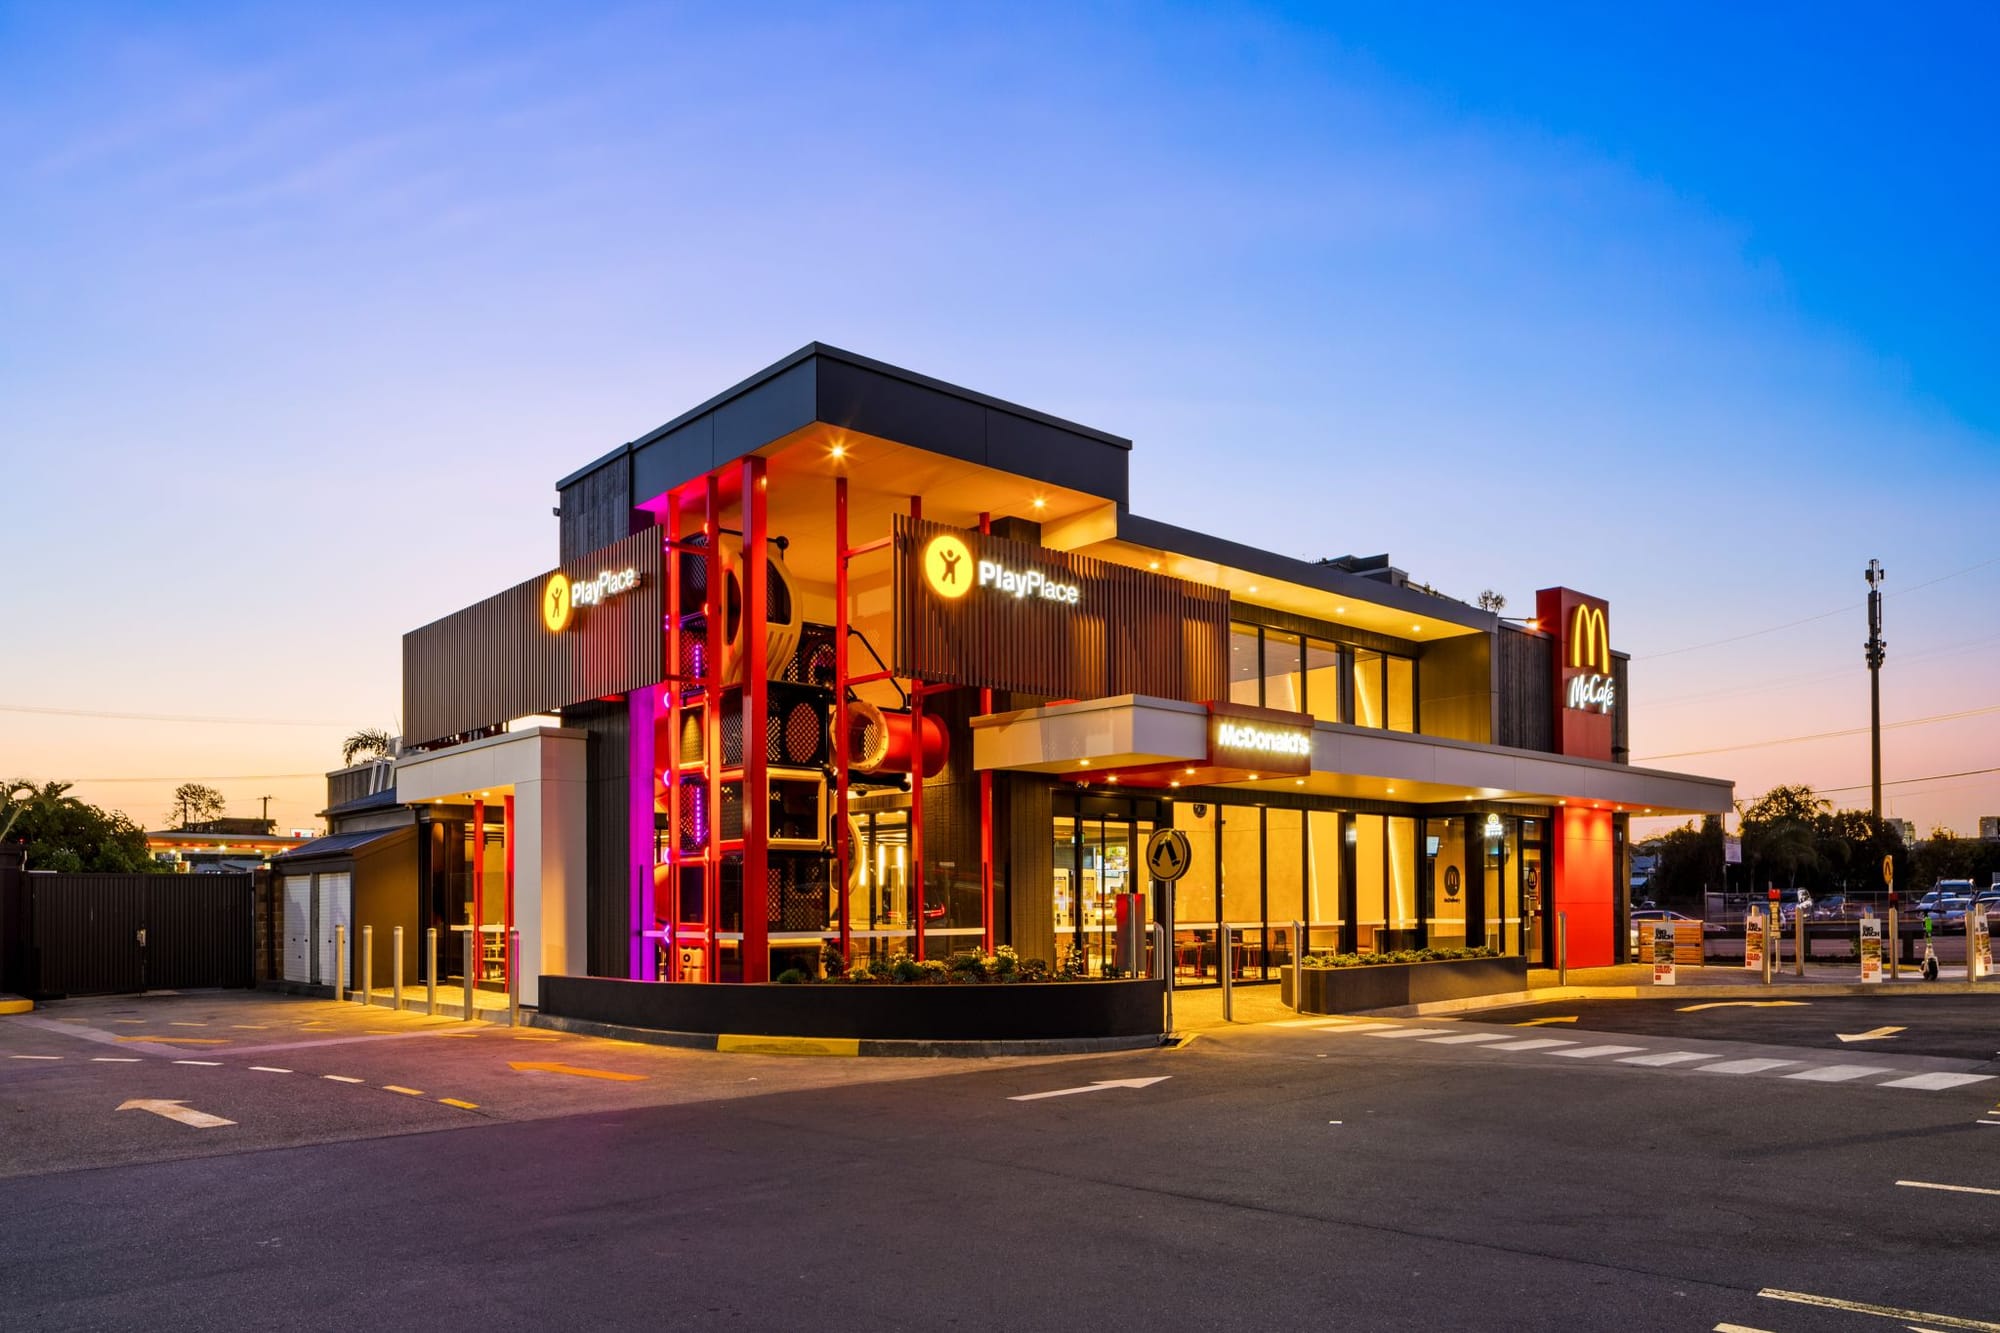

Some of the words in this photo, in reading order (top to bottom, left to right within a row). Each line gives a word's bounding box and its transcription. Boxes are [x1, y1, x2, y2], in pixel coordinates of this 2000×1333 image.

[571, 568, 635, 607] PlayPlace
[979, 561, 1079, 604] PlayPlace
[1570, 674, 1614, 714] McCafé
[1219, 723, 1310, 755] McDonald's
